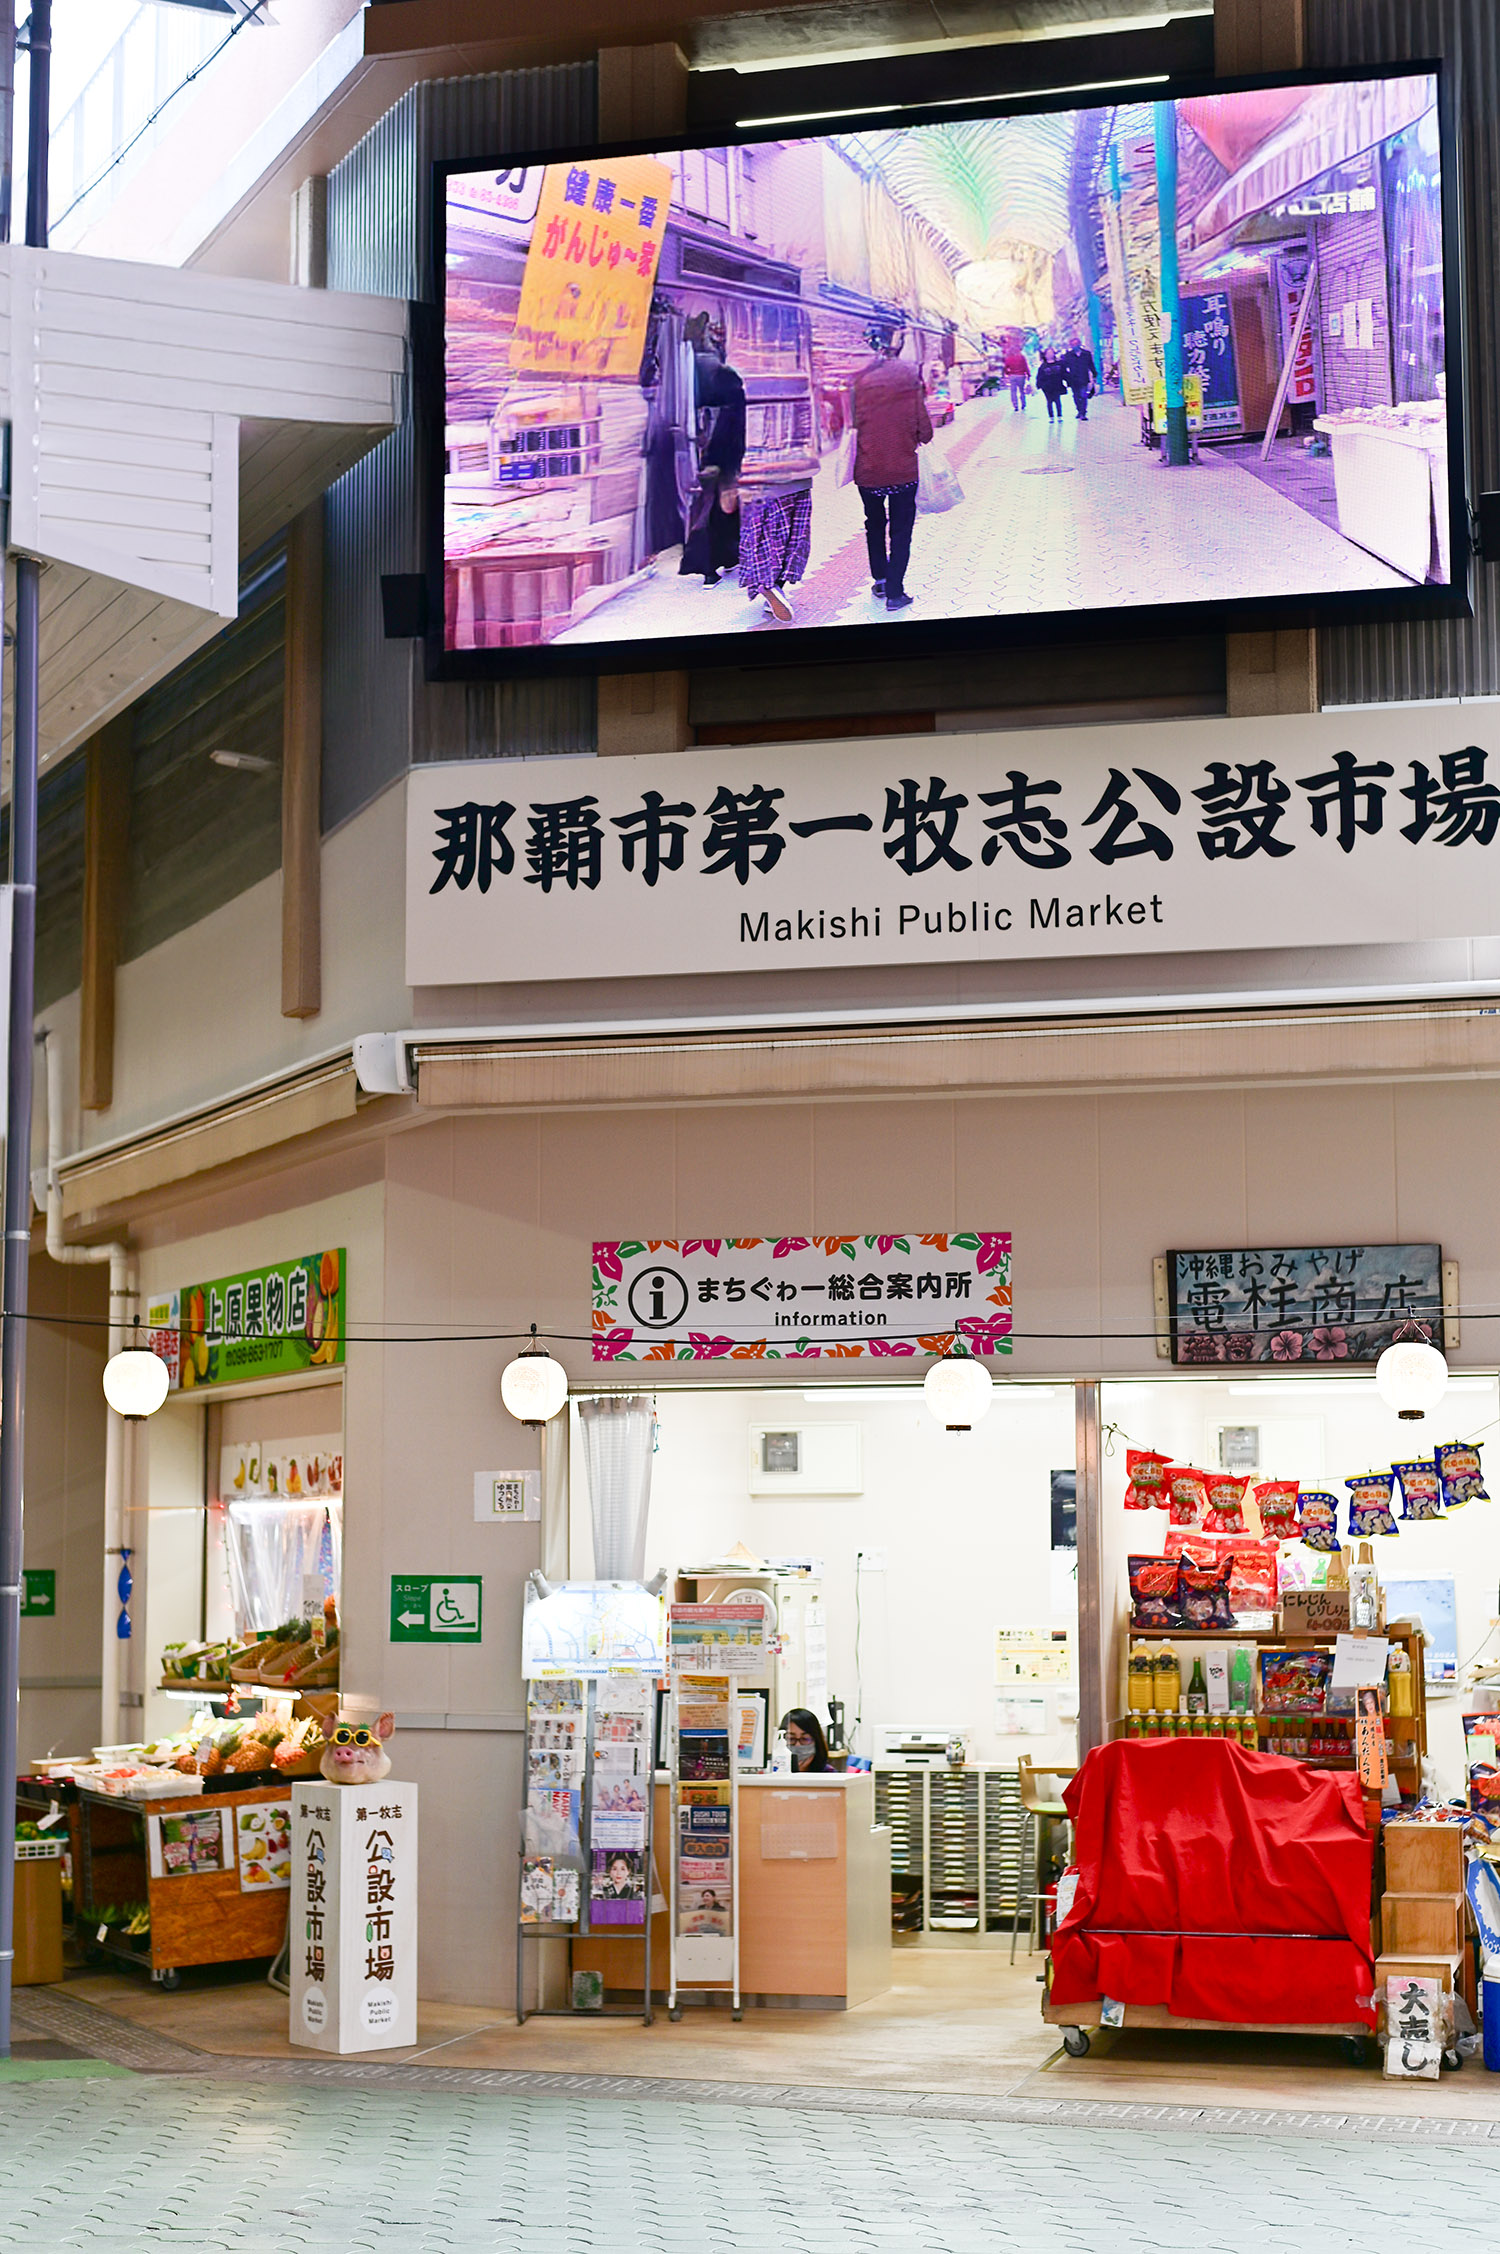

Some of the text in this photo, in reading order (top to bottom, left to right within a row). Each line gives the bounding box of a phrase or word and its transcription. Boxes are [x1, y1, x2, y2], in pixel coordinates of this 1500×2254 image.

[564, 166, 659, 229] 健康一番
[1202, 294, 1229, 356] 耳鳴り
[429, 745, 1500, 894] 那覇市第一牧志公設市場
[739, 893, 1163, 943] Makishi Public Market
[1178, 1248, 1365, 1281] 沖縄おみやげ
[205, 1268, 307, 1343] 上原果物店
[775, 1309, 887, 1326] information
[1186, 1274, 1424, 1333] 電柱商店
[395, 1583, 430, 1593] スロープ
[1283, 1593, 1332, 1608] にんじん
[300, 1803, 331, 1821] 第一牧志
[356, 1804, 402, 1822] 第一牧志
[561, 1791, 571, 1818] NAHA
[305, 1828, 327, 1982] 公設市場
[364, 1828, 396, 1982] 公設市場
[367, 1999, 393, 2008] Makishi
[369, 2007, 390, 2016] Public
[367, 2016, 392, 2025] Market
